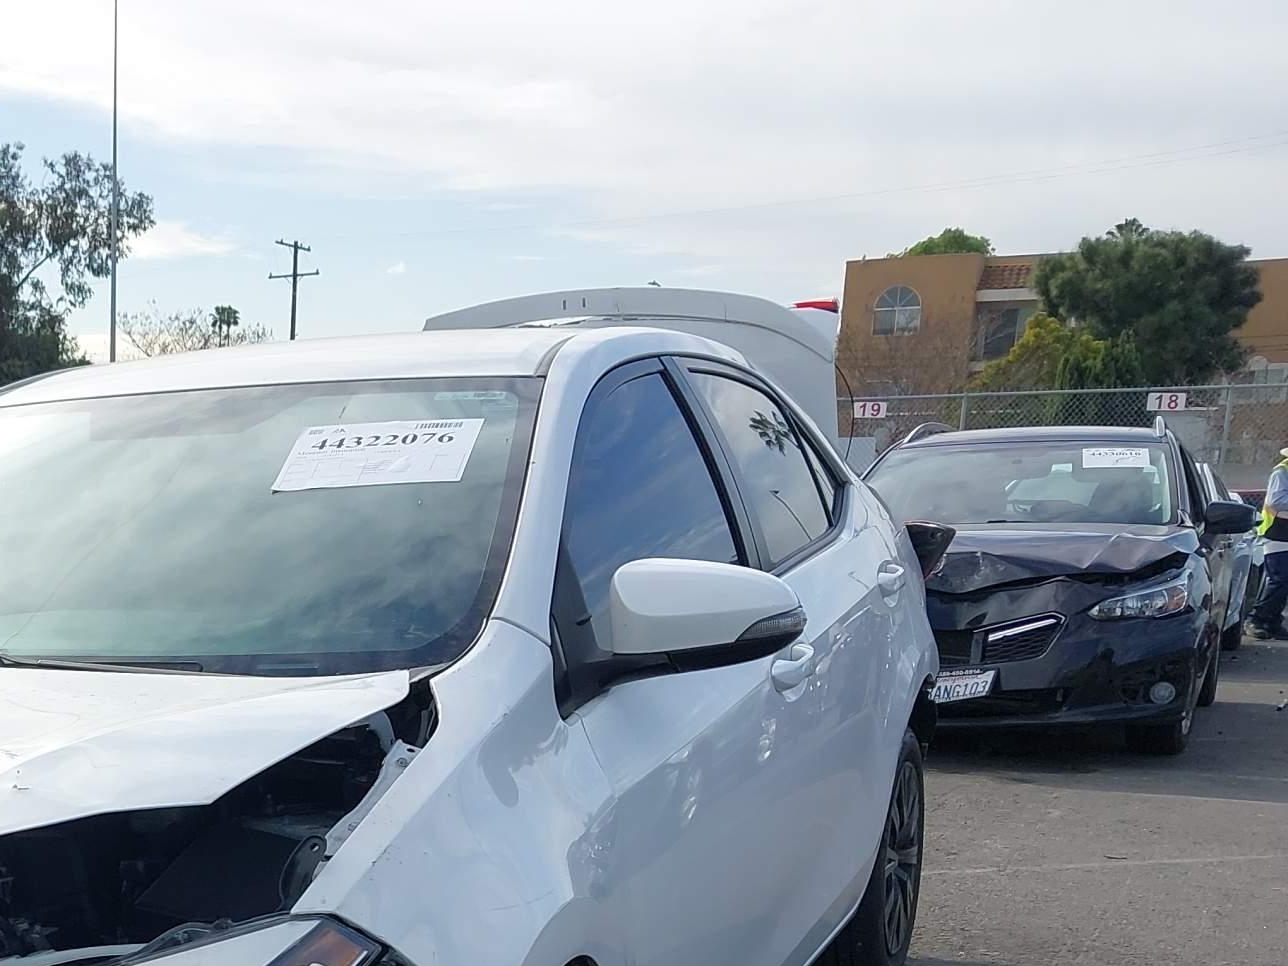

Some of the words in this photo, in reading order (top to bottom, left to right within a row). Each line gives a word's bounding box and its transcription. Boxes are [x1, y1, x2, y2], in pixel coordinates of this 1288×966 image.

[859, 402, 881, 417] 19
[1155, 394, 1179, 410] 18
[311, 431, 456, 451] 44322076
